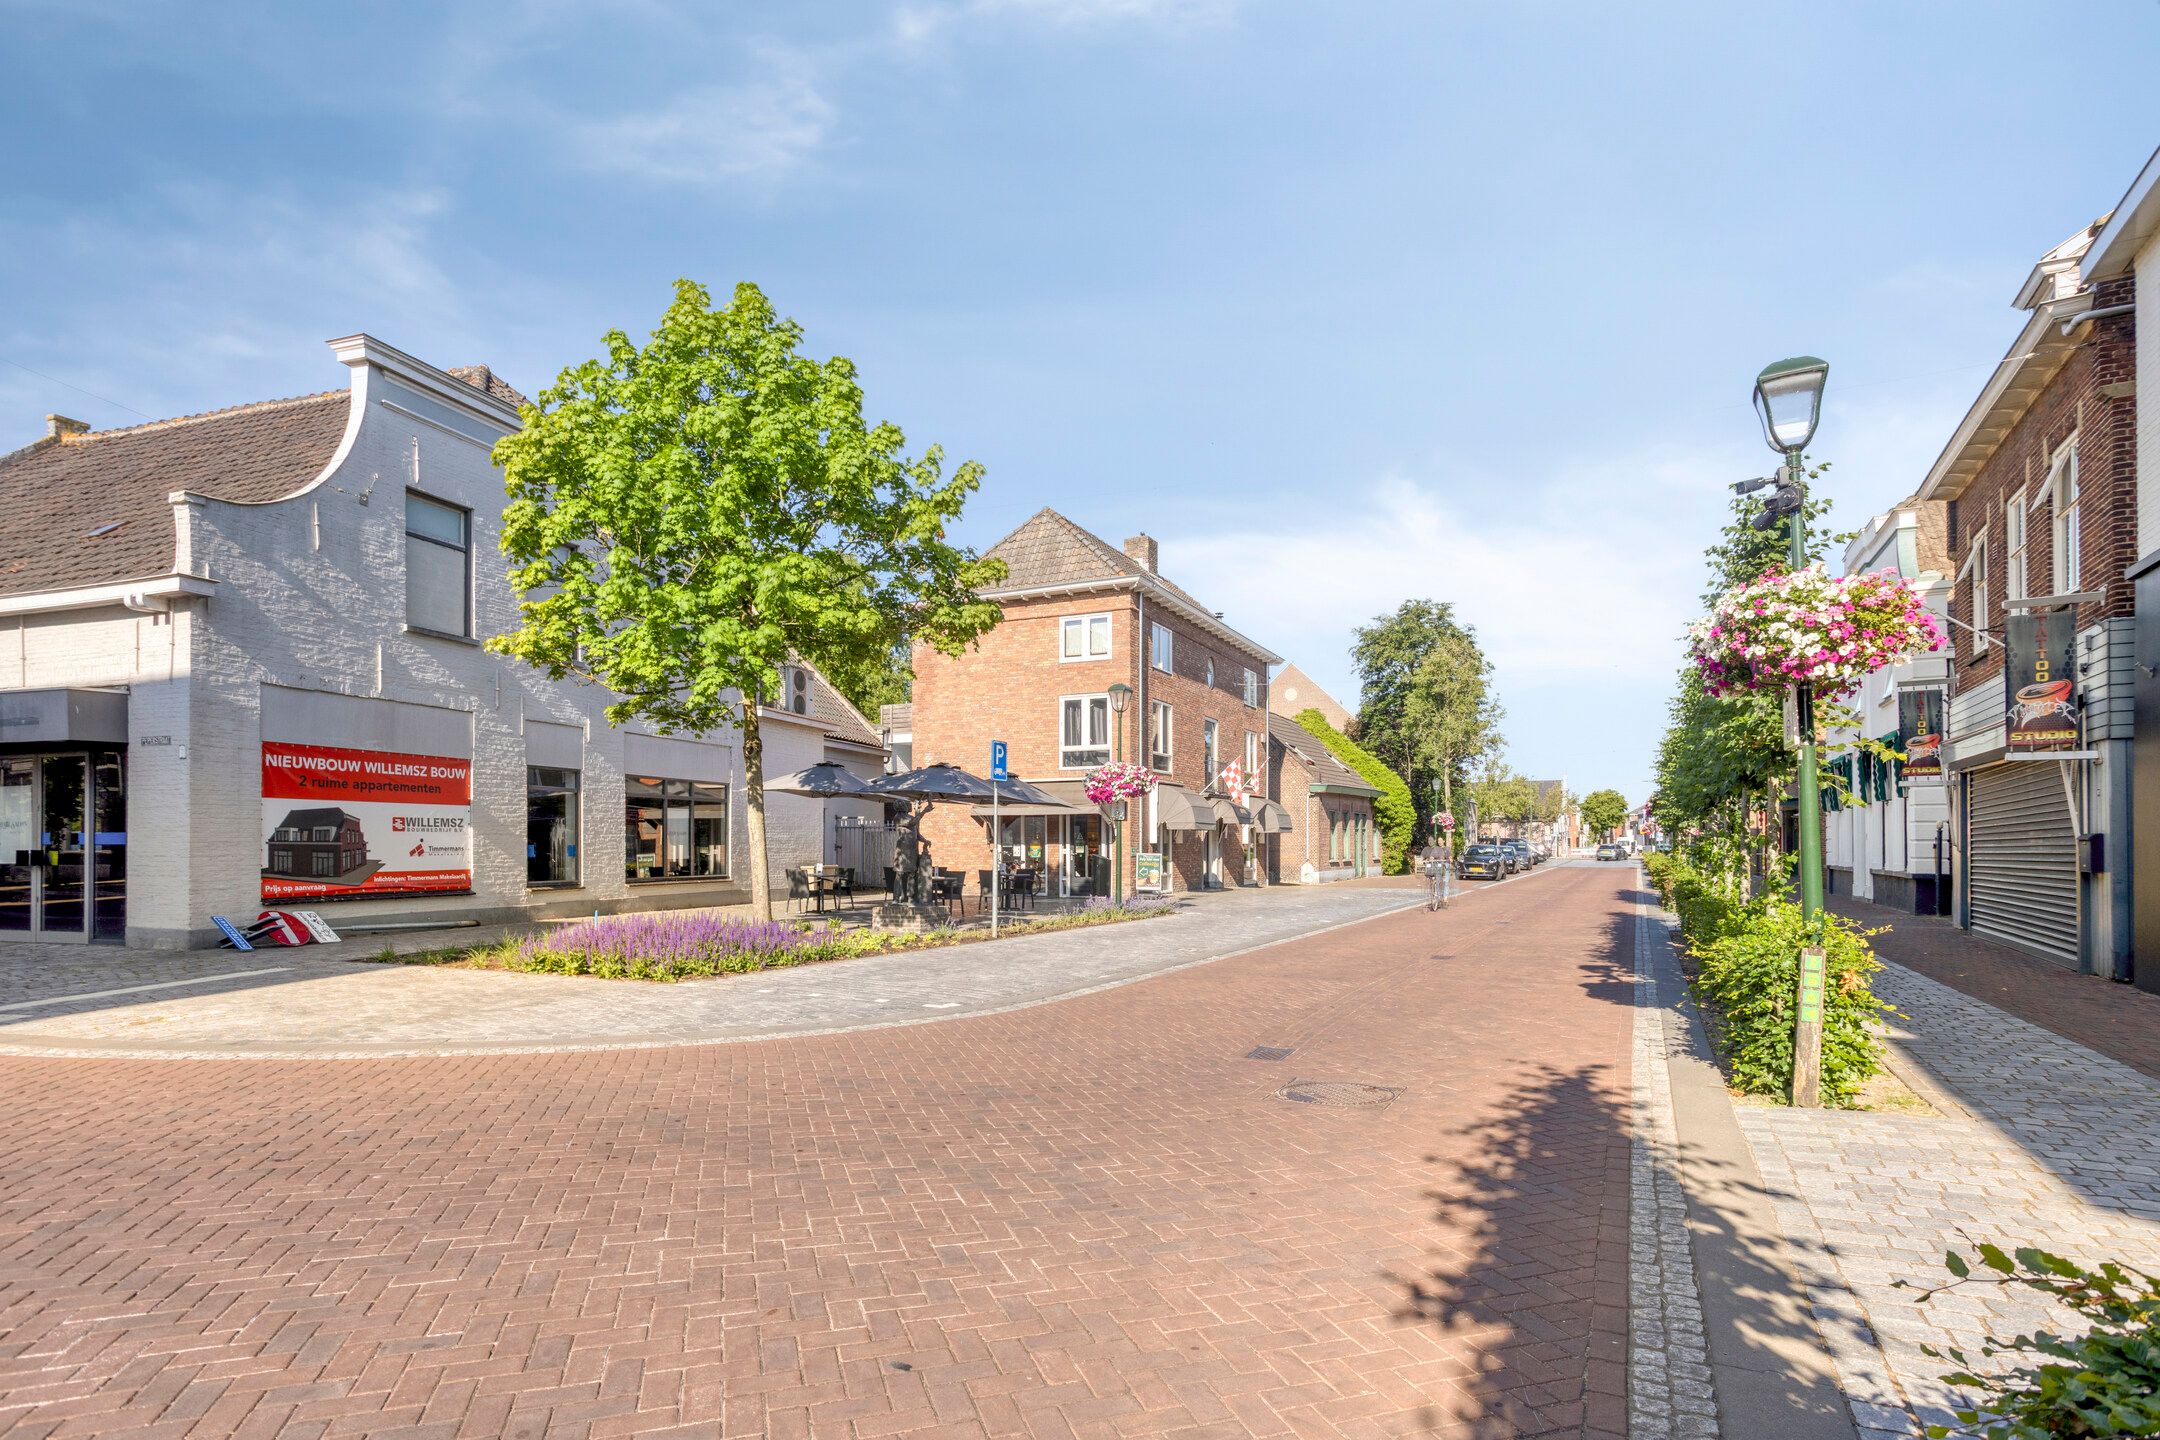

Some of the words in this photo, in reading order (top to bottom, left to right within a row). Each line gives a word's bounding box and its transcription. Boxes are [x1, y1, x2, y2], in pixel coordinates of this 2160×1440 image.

[2035, 616, 2049, 682] TATTOO
[2011, 730, 2077, 741] STUDIO
[995, 745, 1005, 765] P
[265, 753, 361, 772] NIEUWBOUW
[364, 761, 428, 777] WILLEMSZ
[430, 766, 466, 779] BOUW
[298, 775, 307, 787] 2
[311, 778, 349, 789] ruime
[353, 780, 441, 794] appartementen
[406, 817, 464, 828] WILLEMSZ
[264, 884, 281, 894] Prijs
[294, 884, 327, 892] aanvraag
